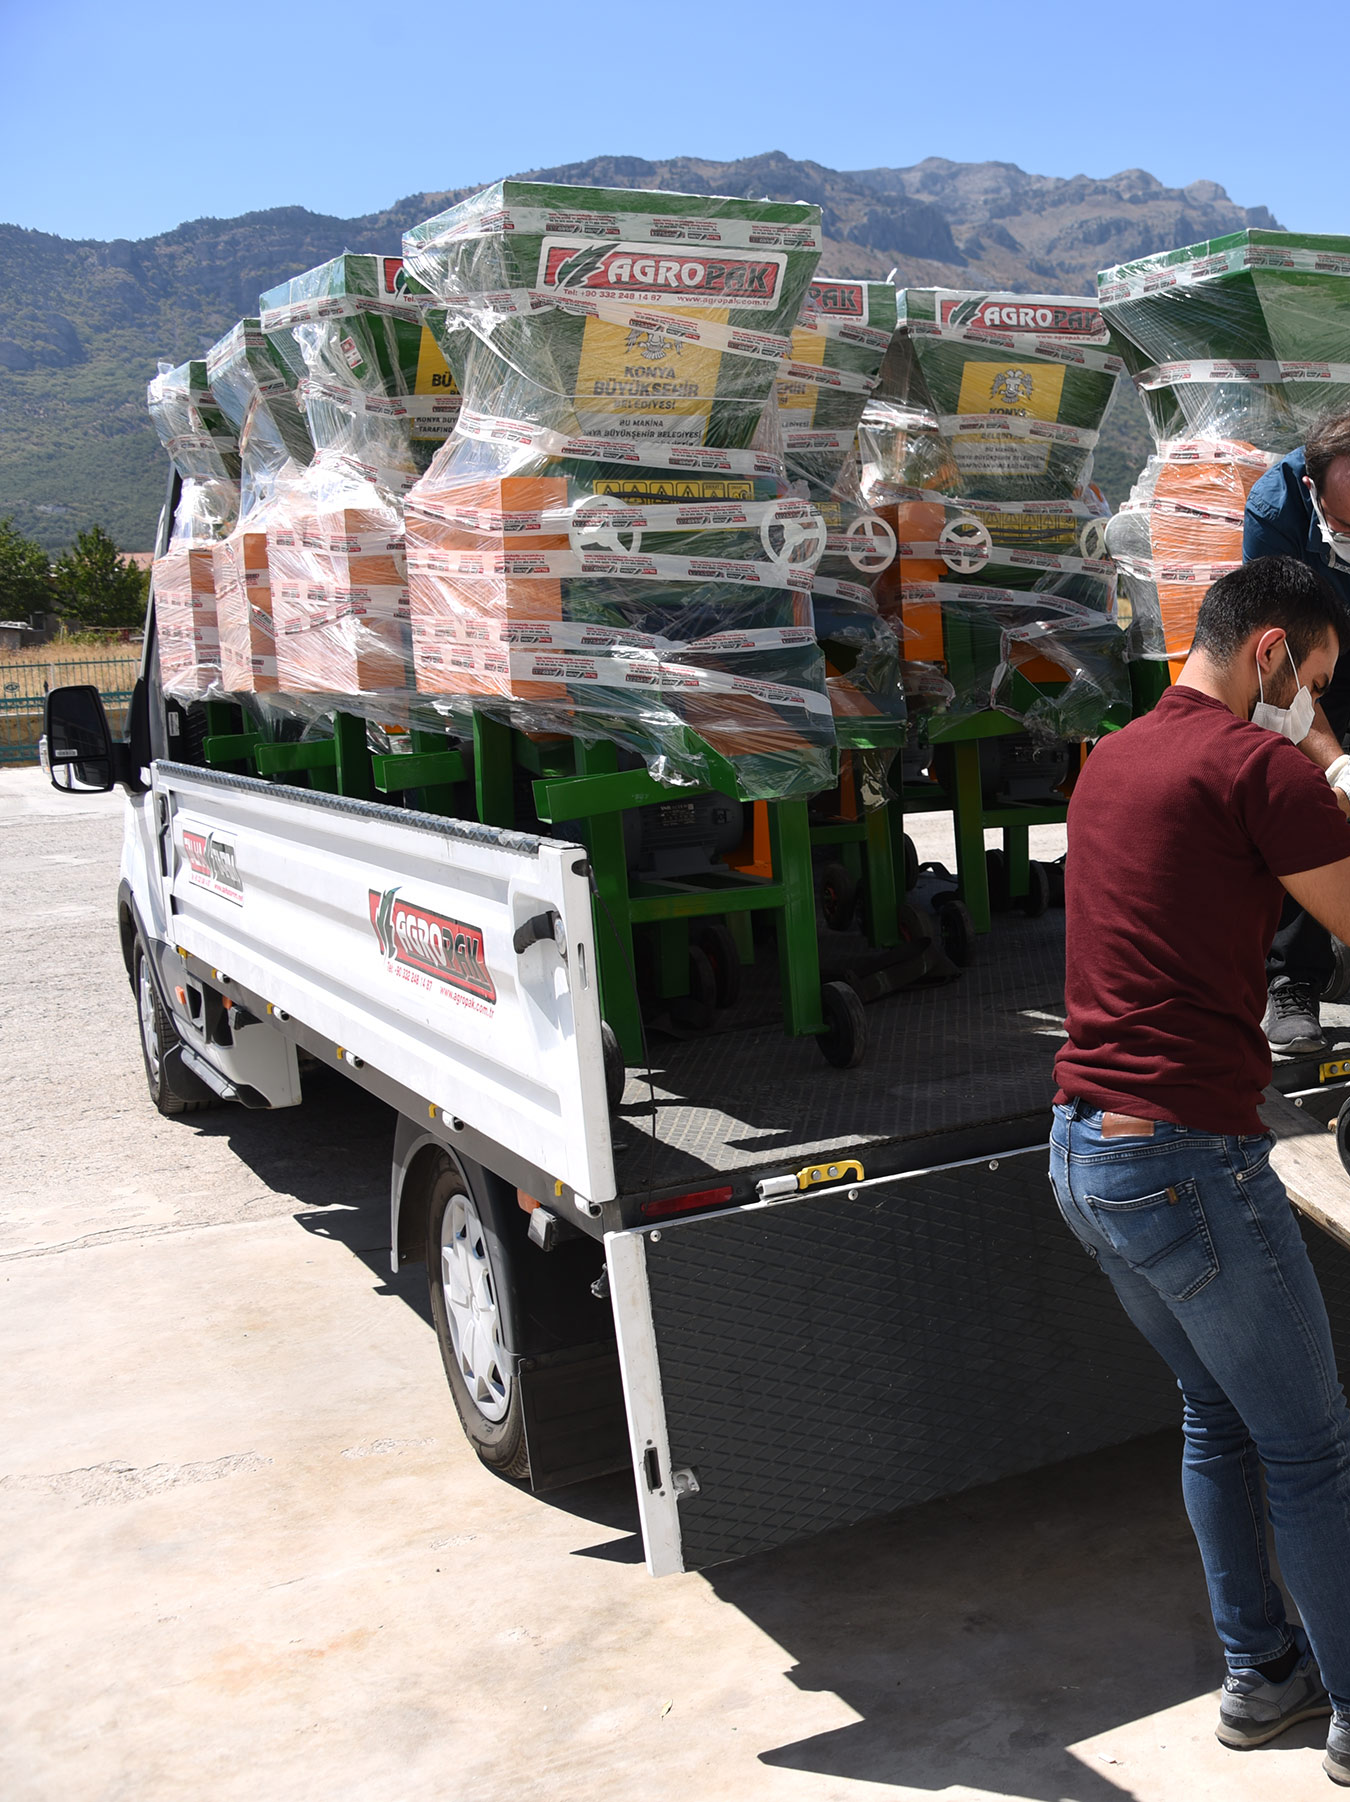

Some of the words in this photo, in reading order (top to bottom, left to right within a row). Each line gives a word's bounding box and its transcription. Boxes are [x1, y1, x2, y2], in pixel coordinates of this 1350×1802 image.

[608, 258, 770, 291] AGROPAK
[599, 291, 616, 299] 332
[618, 292, 635, 300] 248
[984, 306, 1099, 331] AGROPAK
[624, 366, 676, 379] KONYA
[396, 911, 491, 986] AGROPAK
